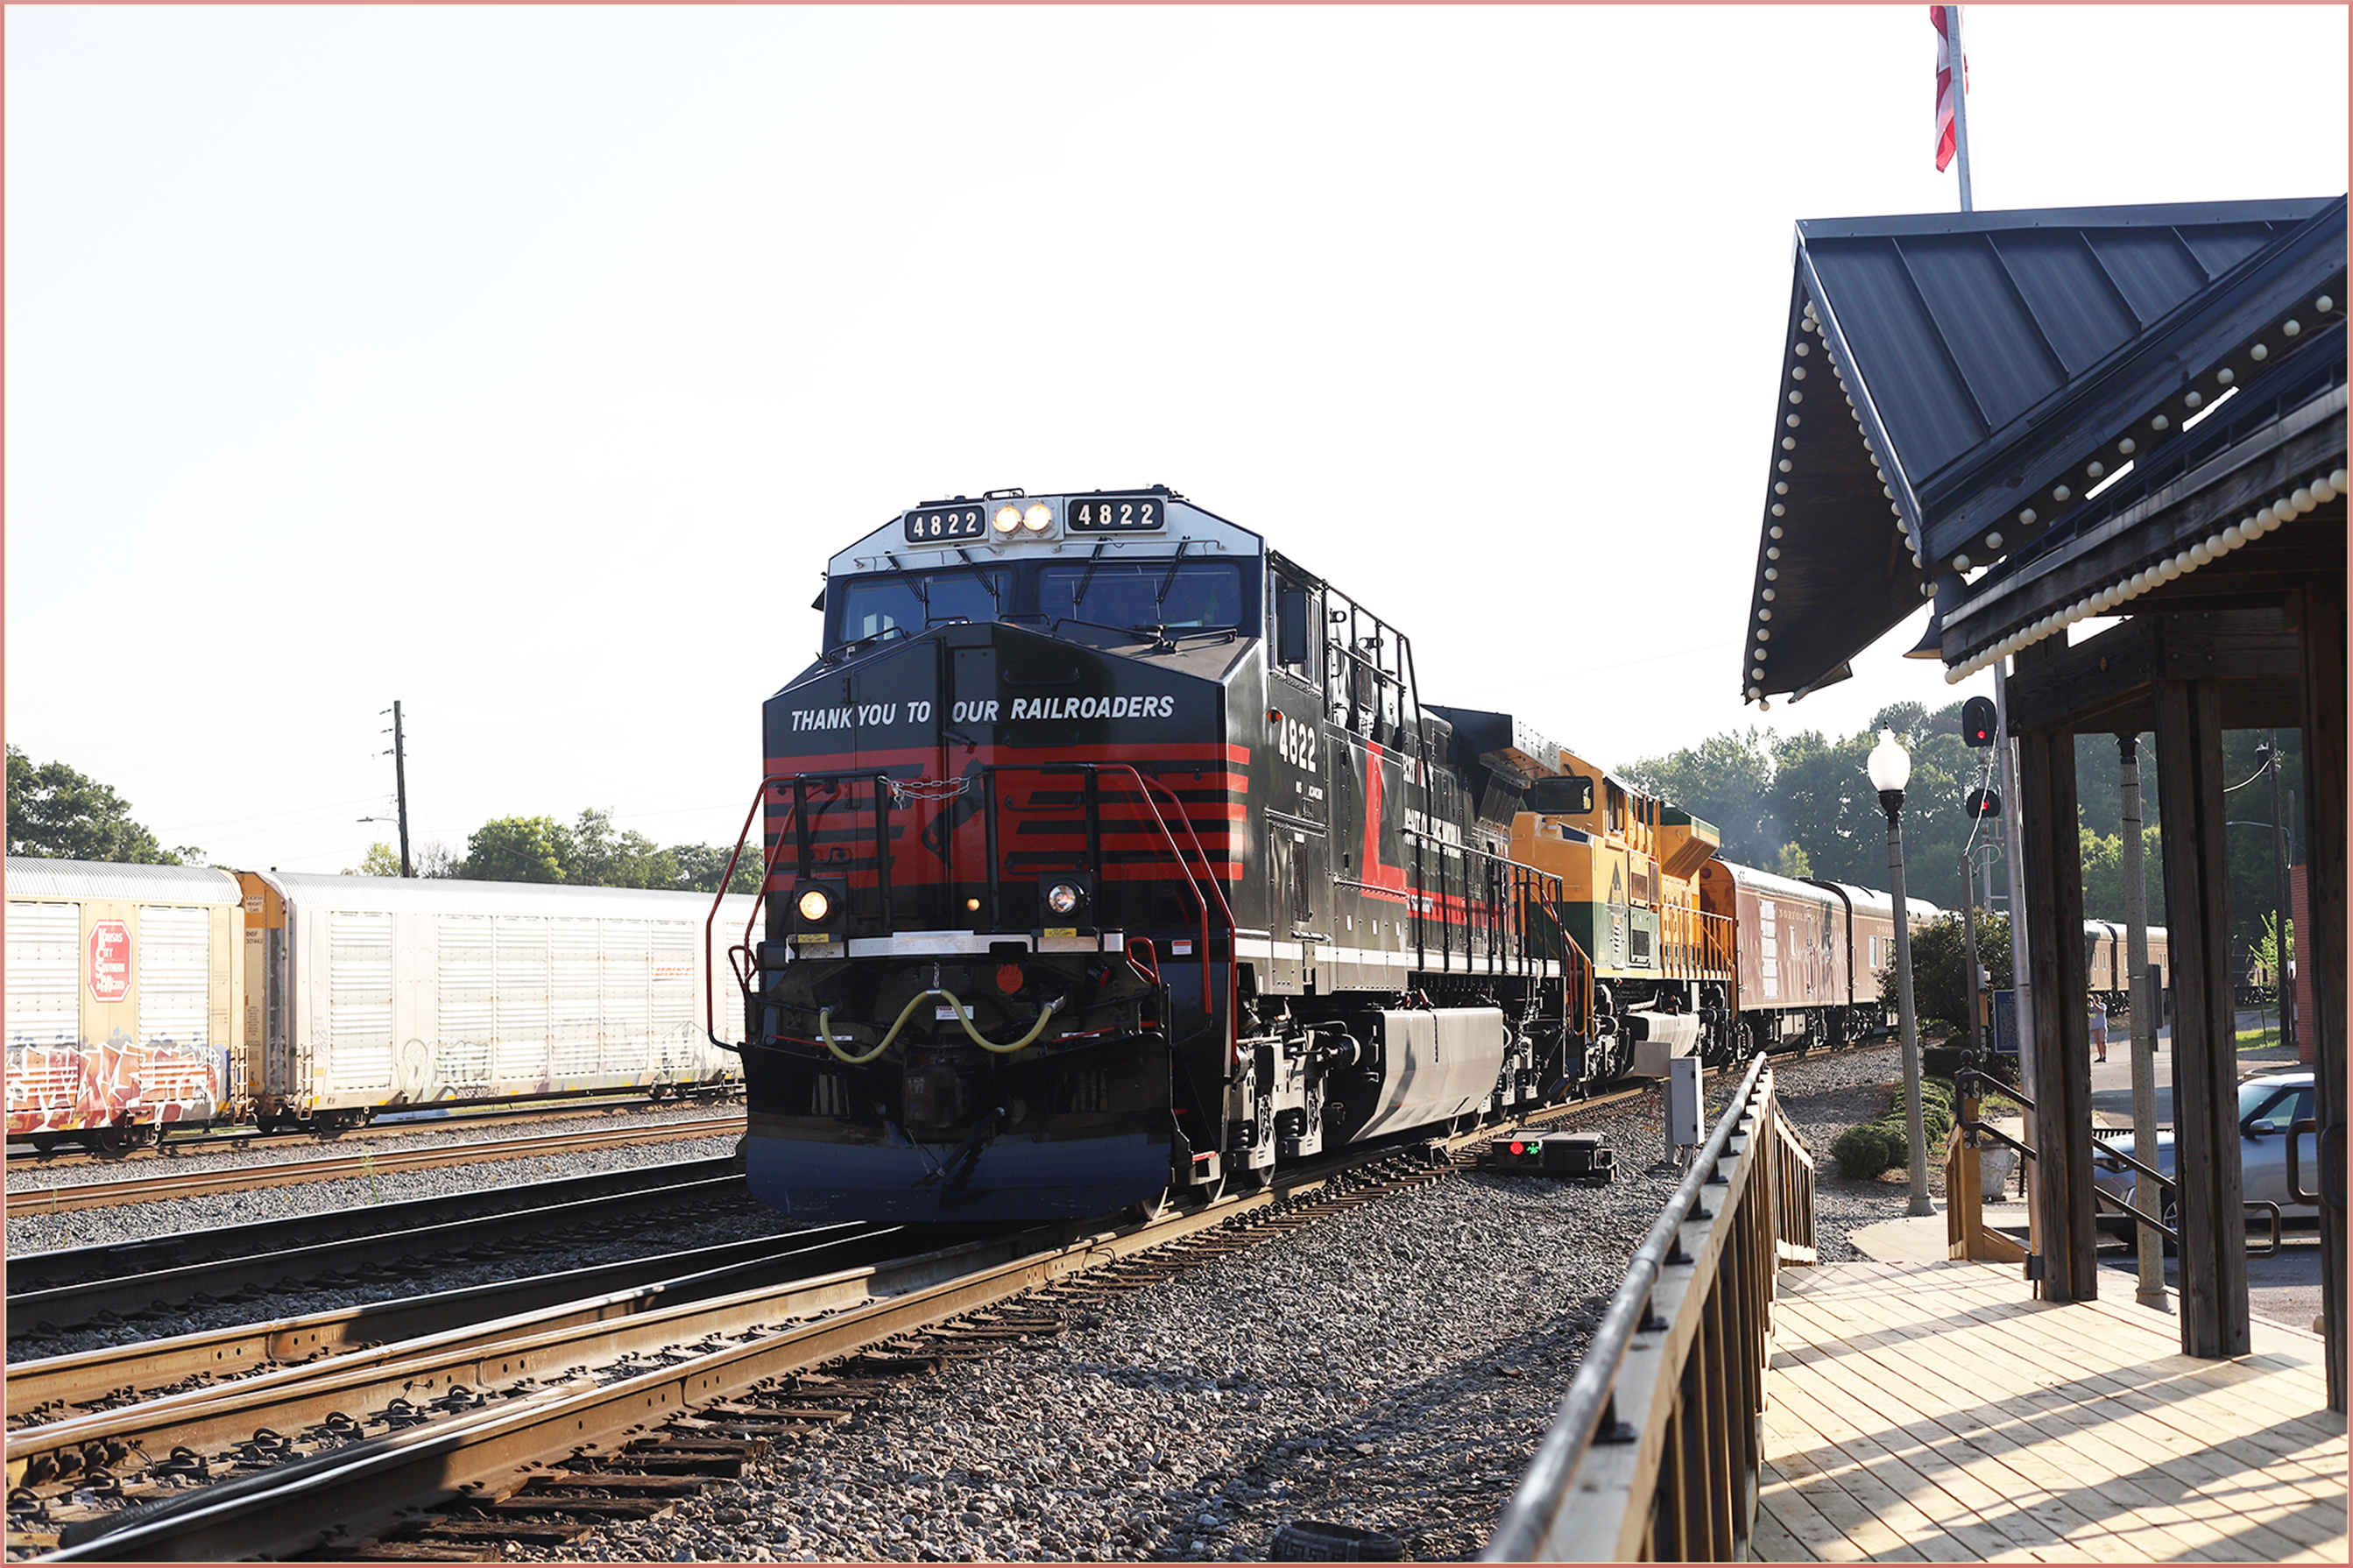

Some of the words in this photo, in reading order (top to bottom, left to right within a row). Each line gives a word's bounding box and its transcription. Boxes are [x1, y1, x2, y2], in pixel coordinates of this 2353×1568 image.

[913, 511, 978, 537] 4822
[1078, 503, 1155, 526] 4822
[790, 707, 853, 732] THANK
[856, 703, 896, 726] YOU
[907, 701, 932, 724] TO
[951, 700, 1000, 724] OUR
[1010, 696, 1175, 720] RAILROADERS
[1279, 715, 1317, 773] 4822
